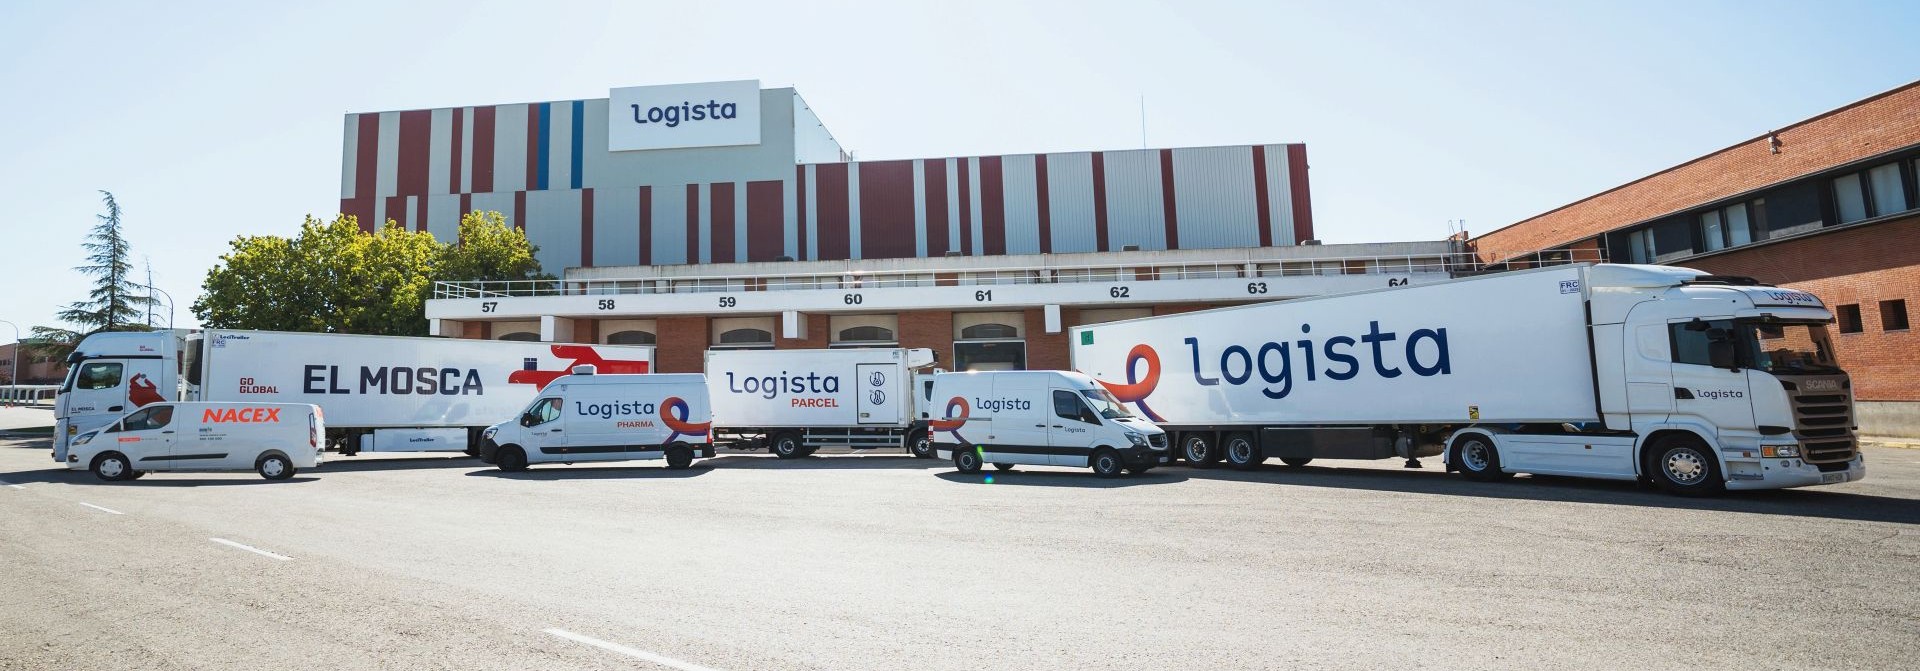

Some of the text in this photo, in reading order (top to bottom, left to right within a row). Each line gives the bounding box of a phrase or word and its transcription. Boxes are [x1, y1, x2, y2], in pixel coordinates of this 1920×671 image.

[630, 99, 737, 128] logista
[1247, 282, 1268, 295] 63
[1560, 281, 1579, 289] FRC
[975, 289, 992, 302] 61
[1109, 286, 1130, 299] 62
[598, 299, 616, 311] 58
[718, 296, 737, 308] 59
[844, 293, 863, 305] 60
[481, 301, 498, 313] 57
[1184, 320, 1452, 400] logista
[239, 377, 255, 386] GO
[303, 364, 484, 396] EL MOSCA
[725, 370, 839, 400] logista
[1806, 379, 1838, 390] SCANIA
[239, 386, 279, 394] GLOBAL
[1697, 389, 1743, 400] logista
[791, 398, 839, 408] PARCEL
[975, 397, 1031, 413] logista
[202, 407, 281, 424] NACEX
[575, 400, 655, 420] logista
[617, 419, 655, 429] PHARMA
